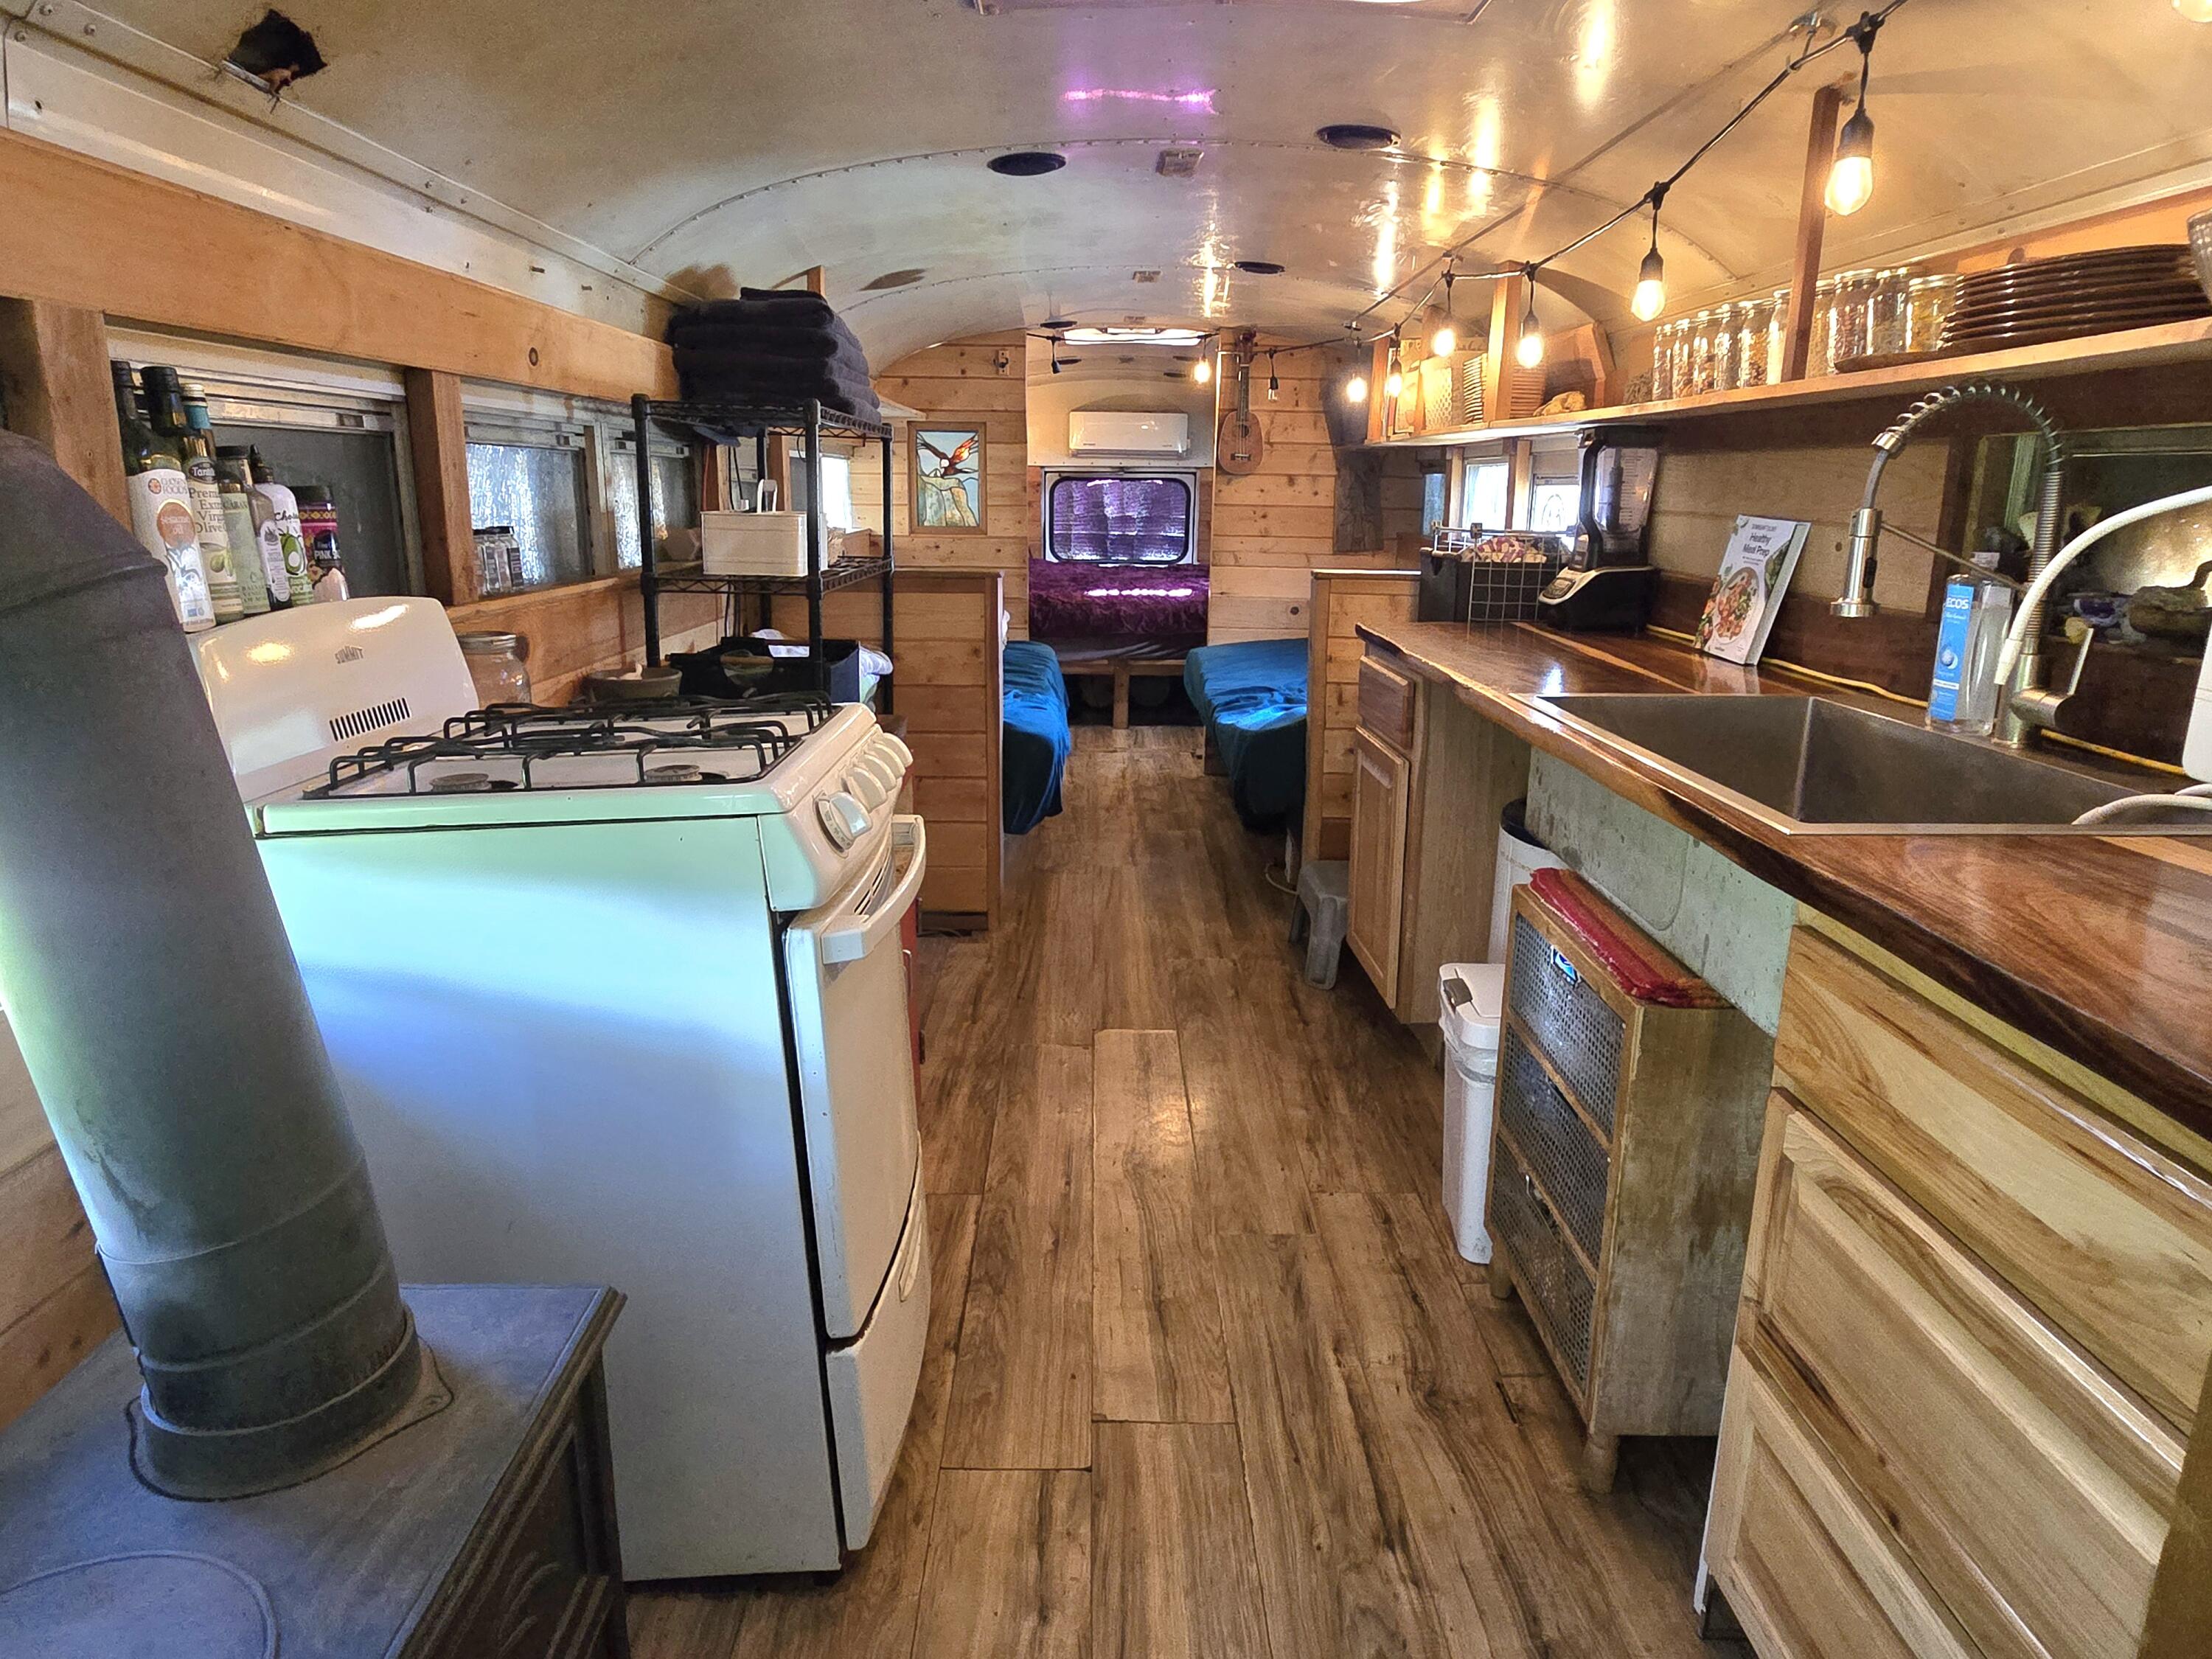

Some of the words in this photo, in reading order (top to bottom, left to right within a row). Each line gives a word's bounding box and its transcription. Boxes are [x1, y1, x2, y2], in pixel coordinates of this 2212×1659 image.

[162, 485, 189, 494] FOODS
[188, 487, 220, 498] Prem
[1749, 532, 1773, 546] Healthy
[314, 550, 332, 560] PINK
[1742, 543, 1756, 554] Meal
[1756, 545, 1770, 558] Prep
[1946, 597, 1969, 610] ECOS
[334, 645, 364, 664] SUMMIT
